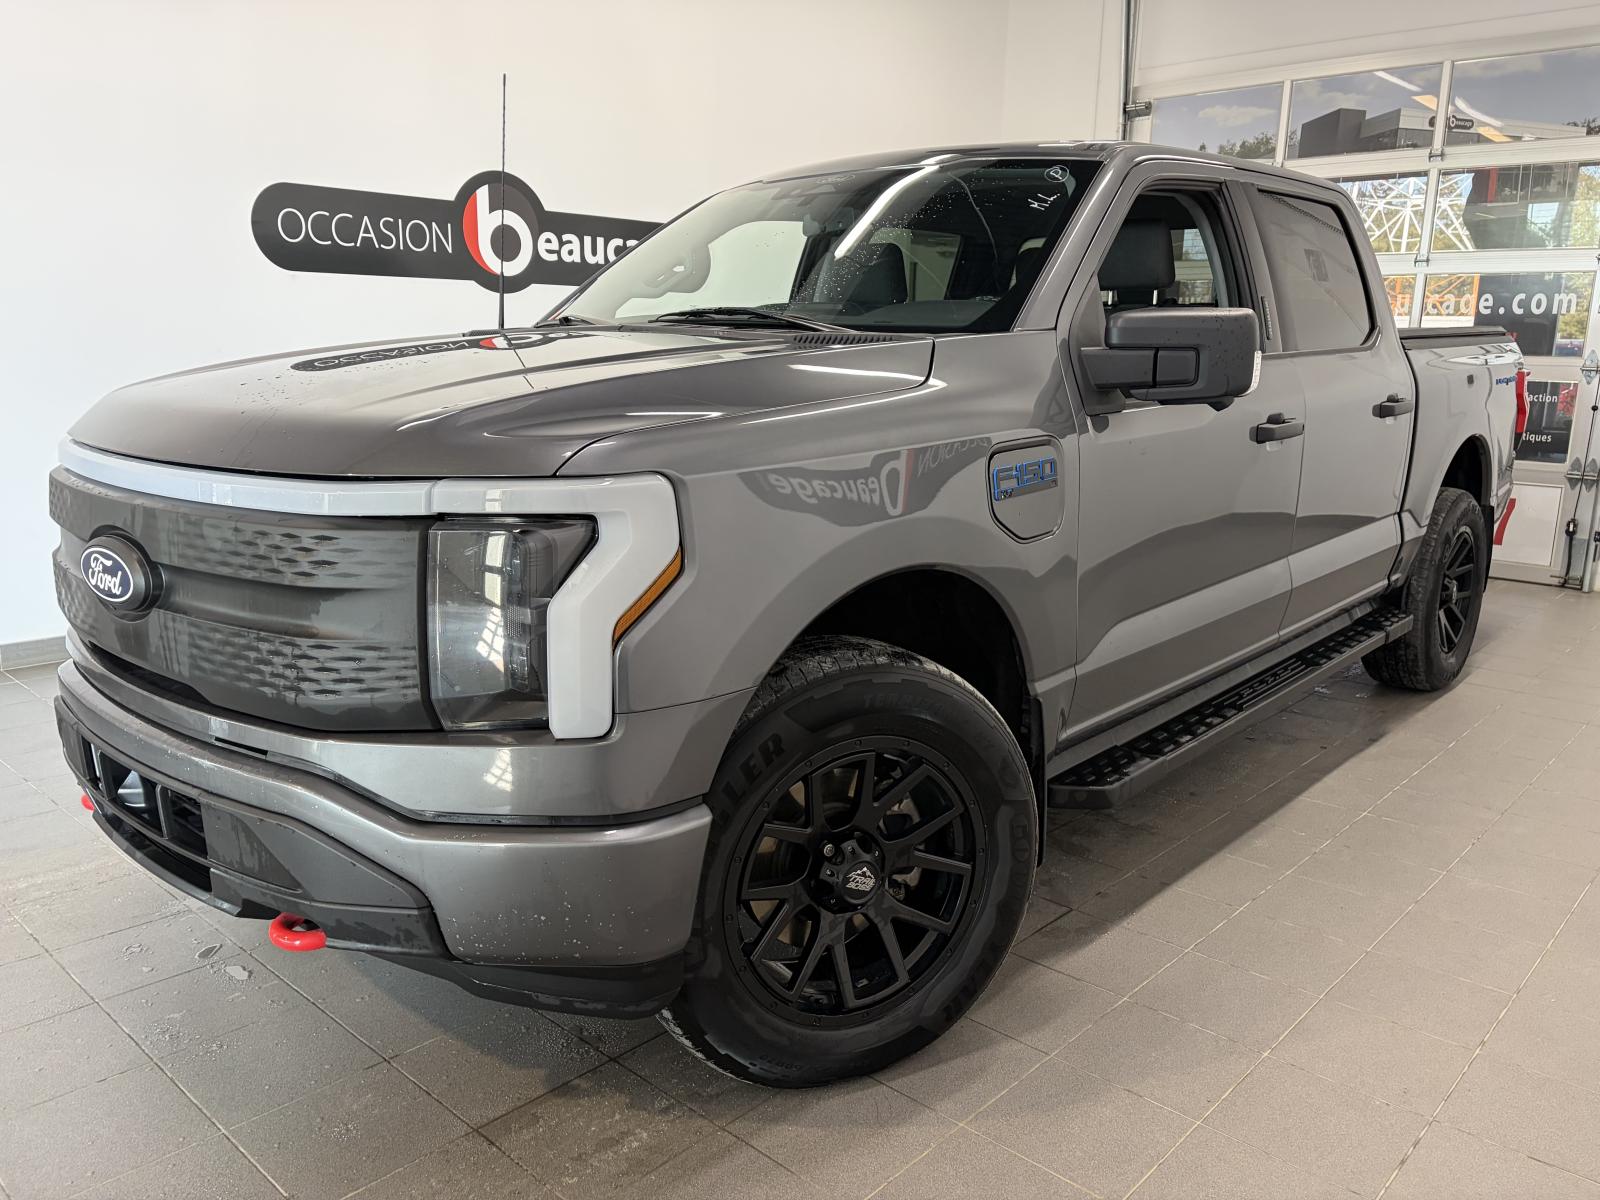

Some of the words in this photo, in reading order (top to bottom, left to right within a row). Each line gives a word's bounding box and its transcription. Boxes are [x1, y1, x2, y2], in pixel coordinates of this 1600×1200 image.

[277, 206, 453, 254] OCCASION
[474, 183, 640, 277] beauc
[88, 553, 122, 595] Ford
